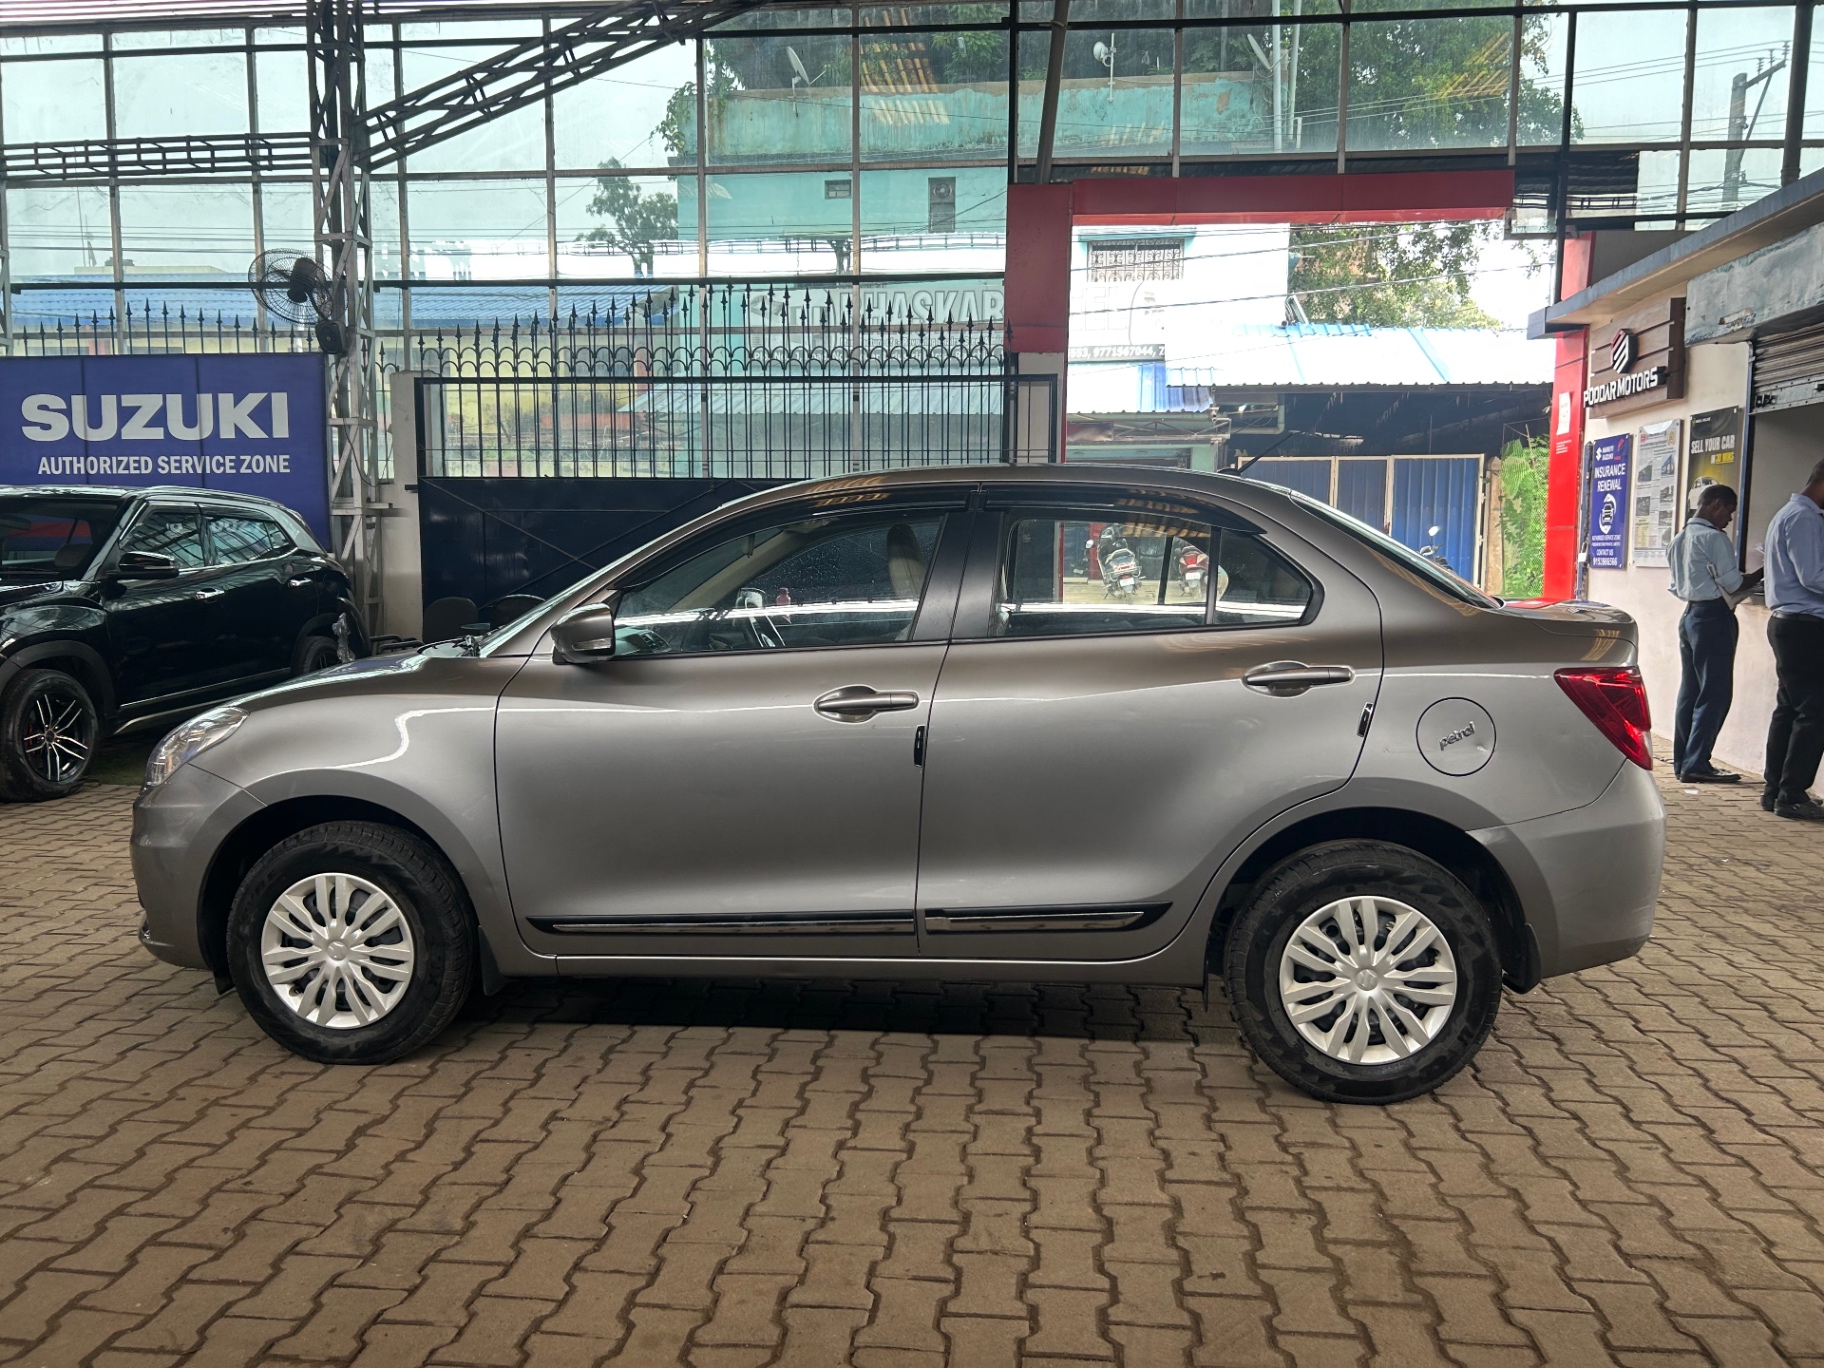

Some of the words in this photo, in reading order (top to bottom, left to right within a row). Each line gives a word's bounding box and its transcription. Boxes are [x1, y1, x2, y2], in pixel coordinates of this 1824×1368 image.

[1583, 380, 1617, 409] PODDAR
[1617, 366, 1658, 397] MOTORS
[21, 392, 289, 442] SUZUKI
[1691, 440, 1704, 454] SELL
[1705, 437, 1721, 452] YOUR
[1721, 434, 1735, 449] CAR
[38, 456, 153, 475] AUTHORIZED
[157, 456, 236, 474] SERVICE
[240, 455, 291, 473] ZONE
[1594, 463, 1626, 478] INSURANCE
[1597, 479, 1622, 492] RENEWAL
[1439, 721, 1475, 751] petrol
